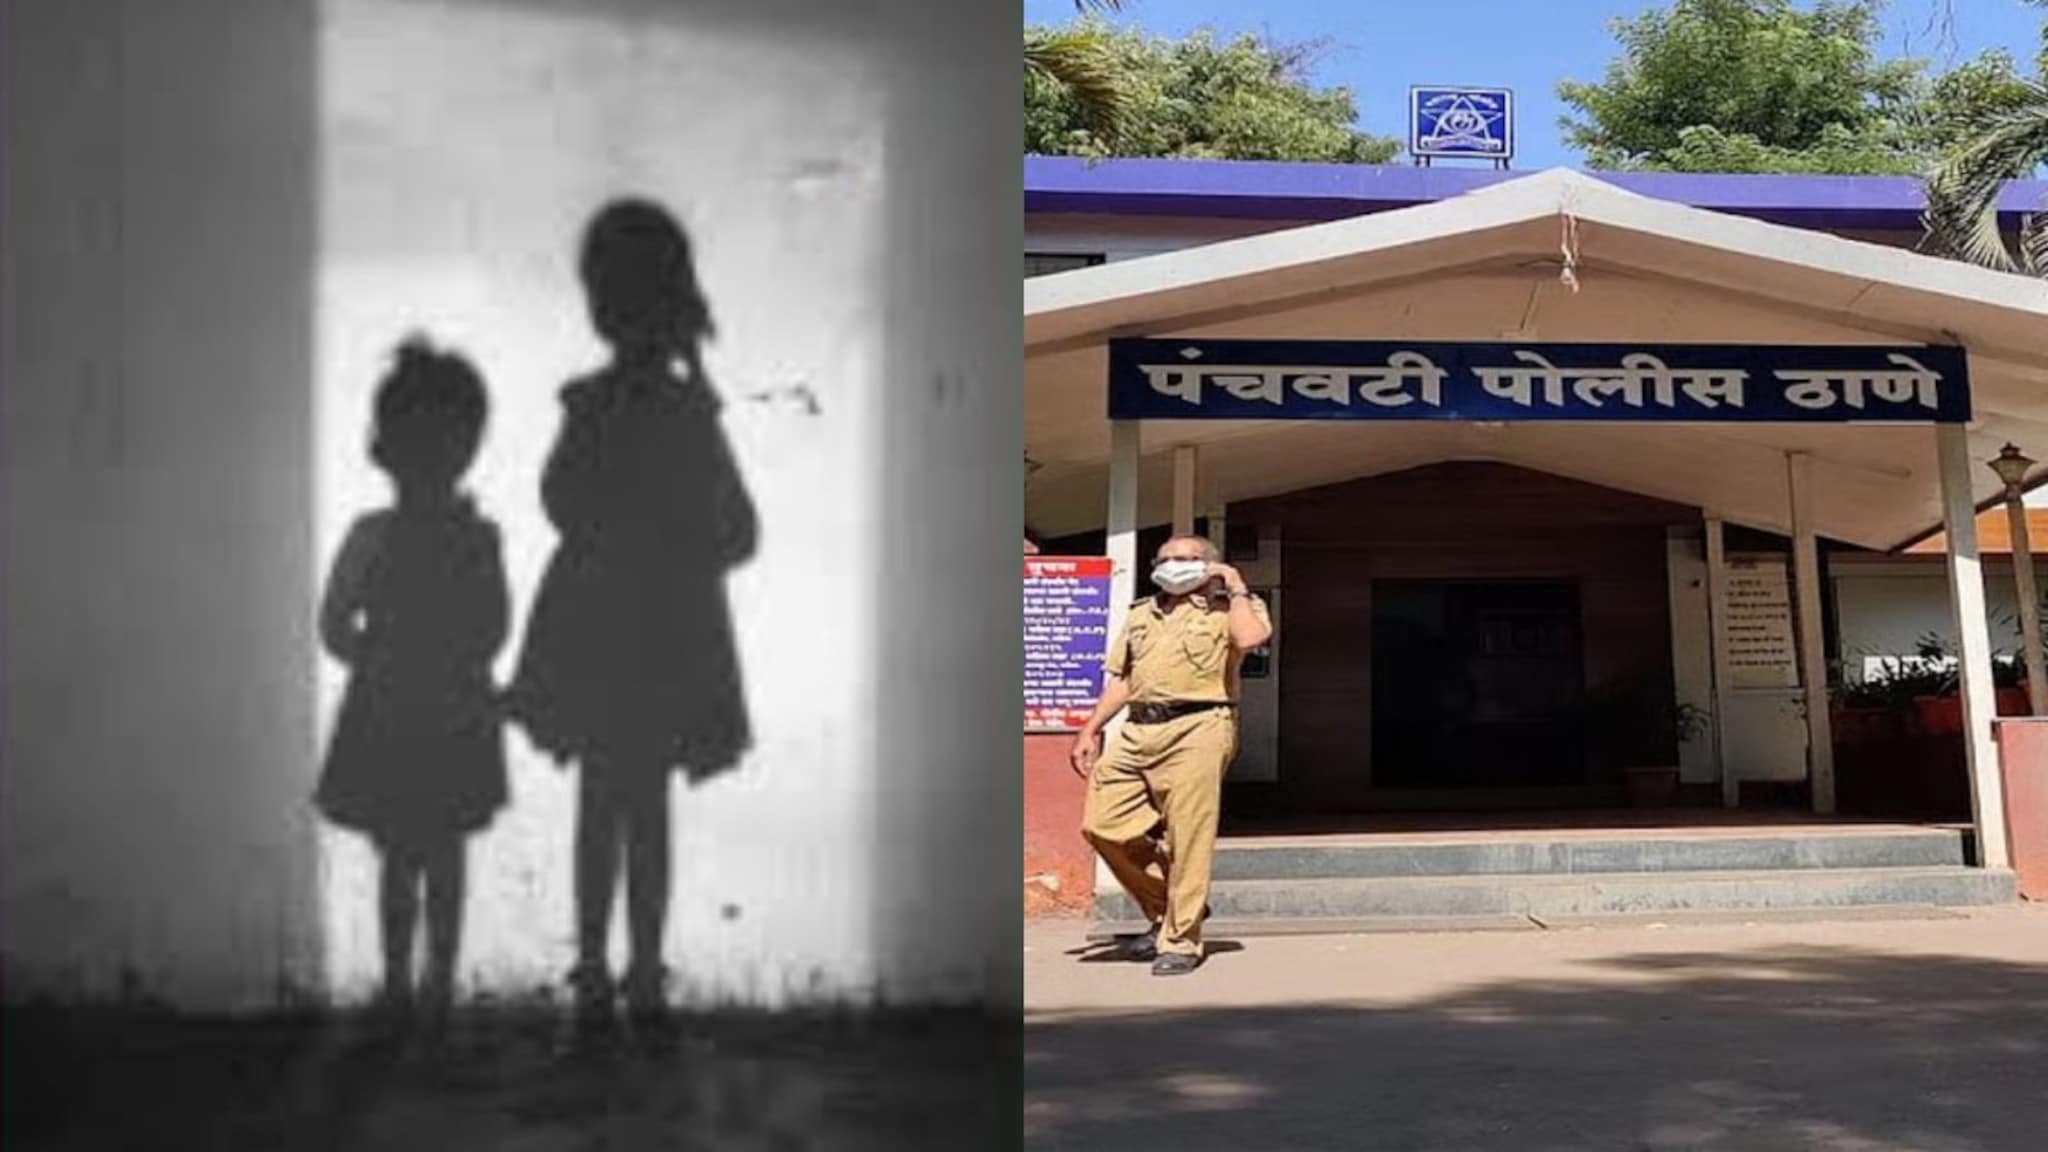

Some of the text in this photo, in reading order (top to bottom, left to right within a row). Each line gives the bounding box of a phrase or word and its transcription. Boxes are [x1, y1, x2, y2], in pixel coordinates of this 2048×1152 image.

[1139, 348, 1942, 409] पंचवटी पोलीस ठाणे
